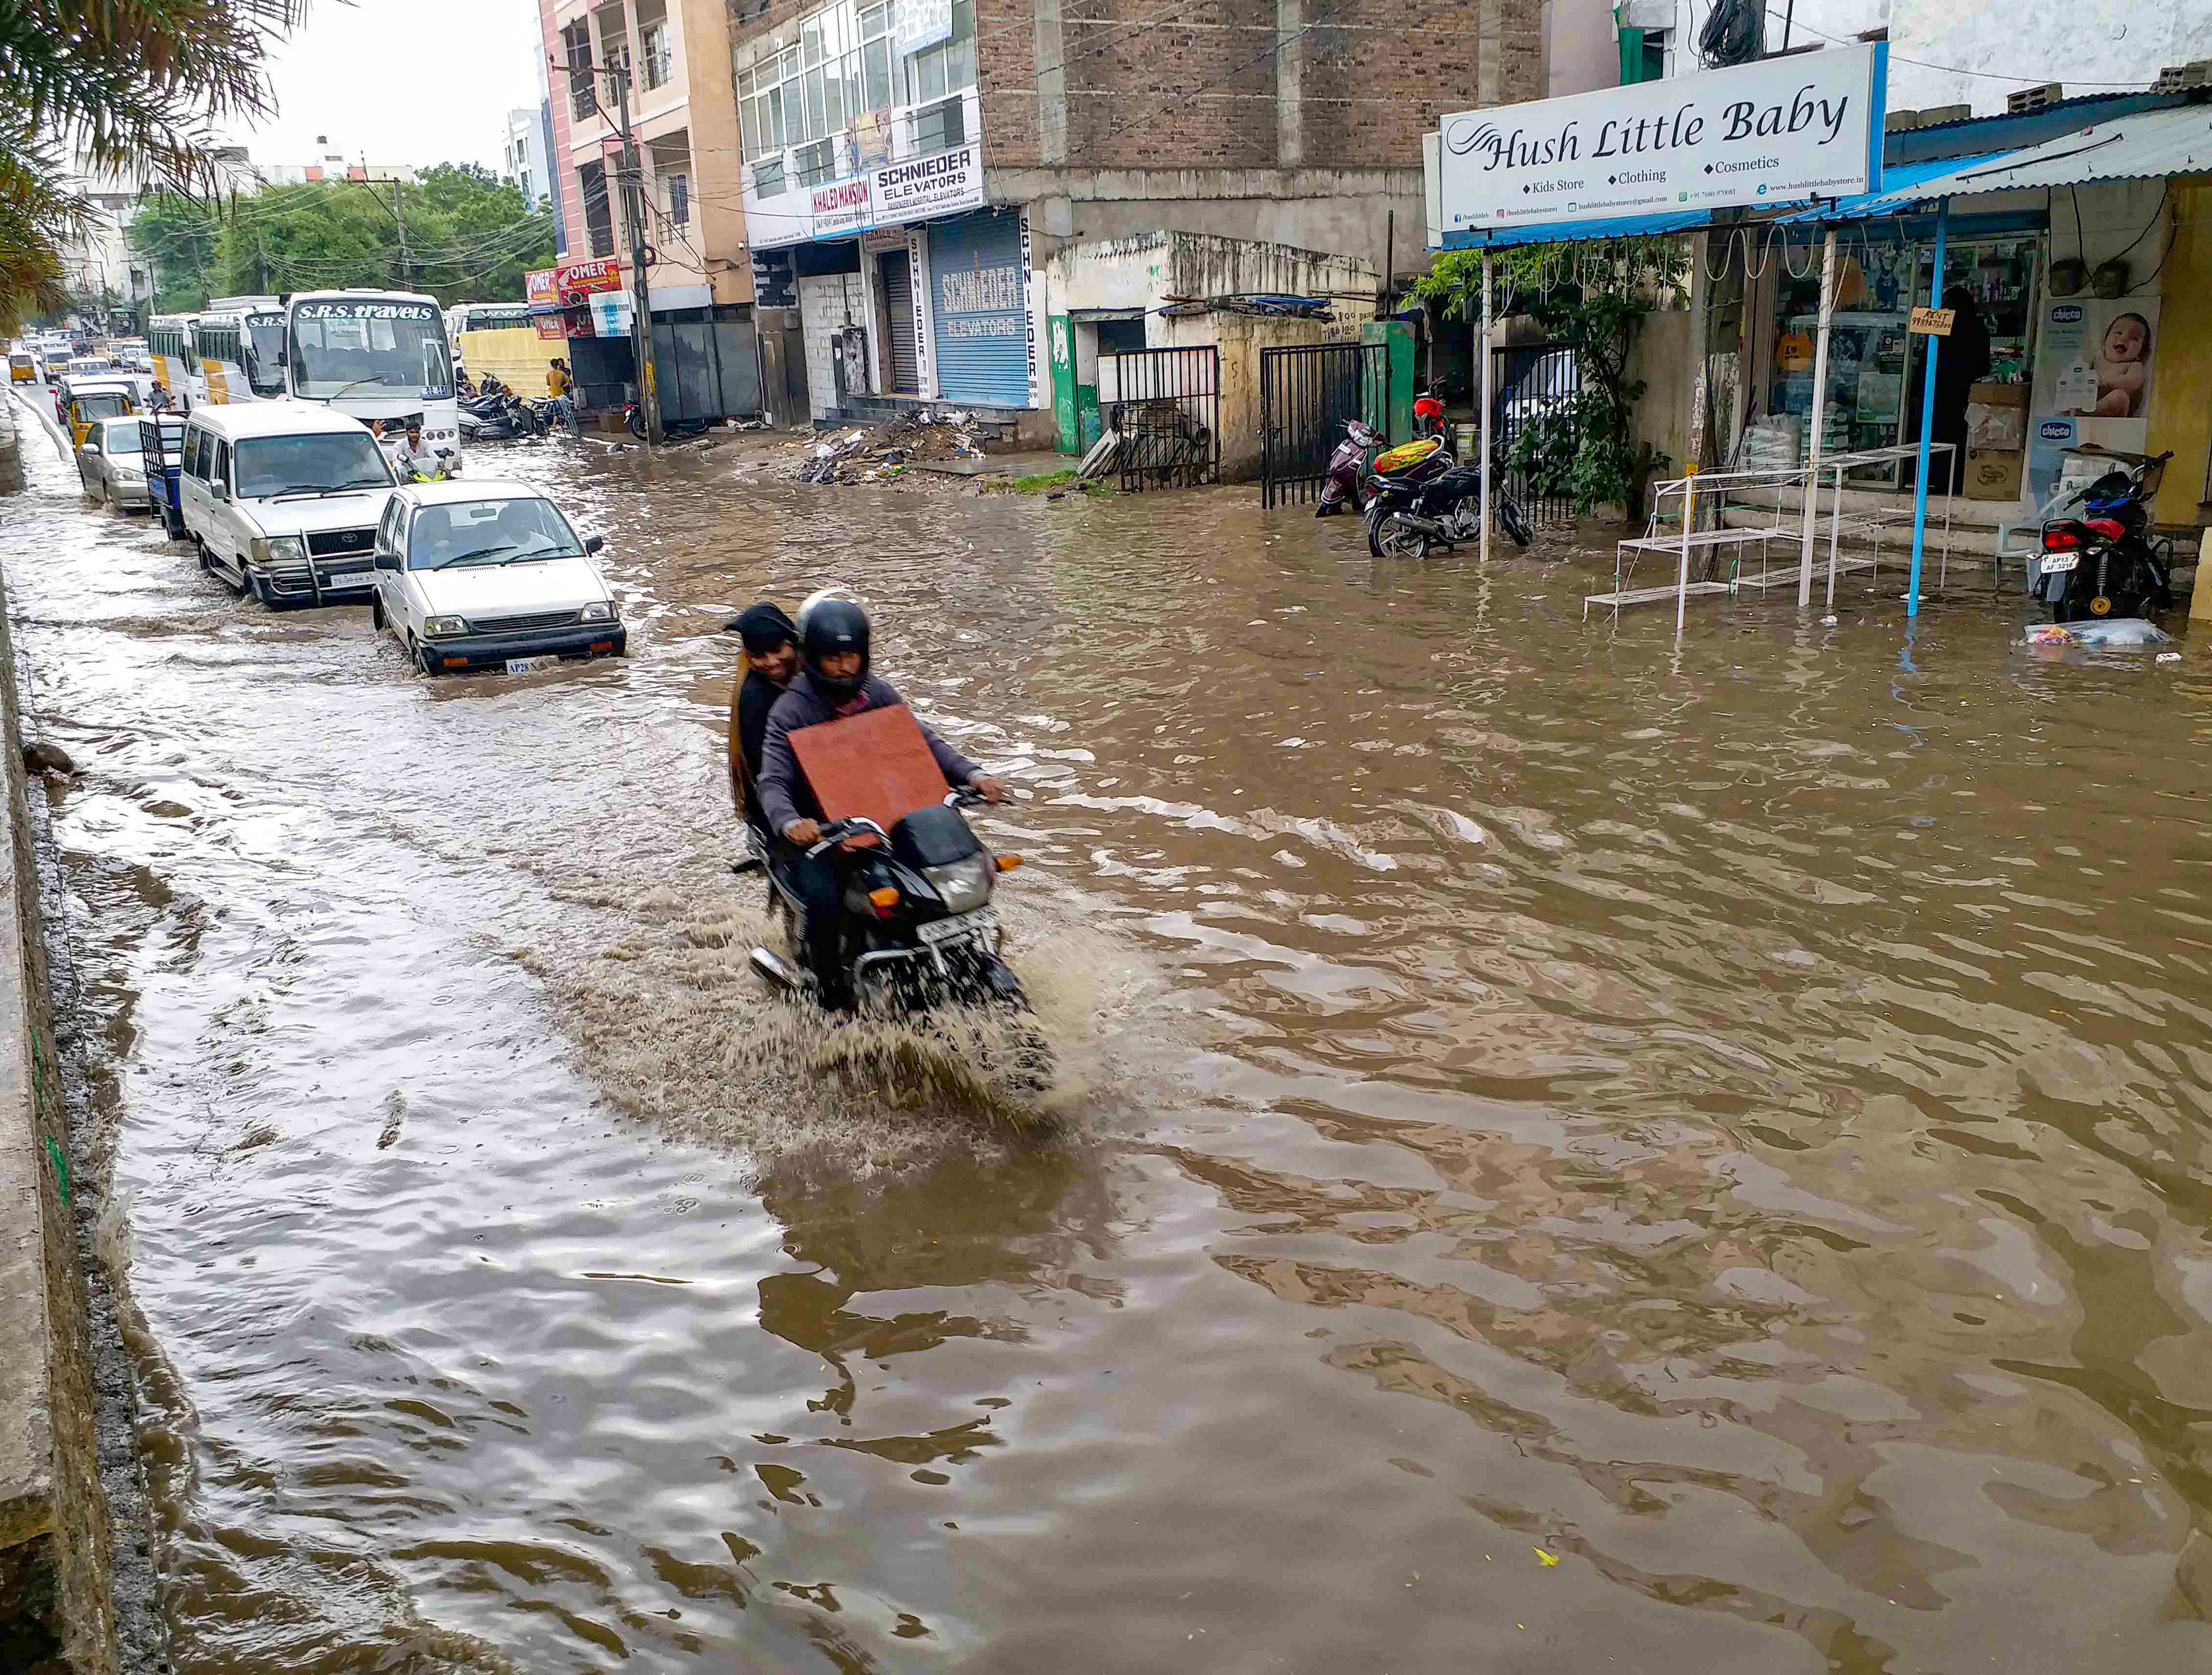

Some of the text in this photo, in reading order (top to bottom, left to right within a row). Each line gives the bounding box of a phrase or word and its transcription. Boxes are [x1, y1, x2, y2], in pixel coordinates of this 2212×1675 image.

[1483, 84, 1848, 171] Hush Little Baby
[878, 149, 971, 188] SCHNIEDER
[1715, 156, 1779, 174] Cosmetics
[884, 171, 966, 200] ELEVATORS
[1618, 169, 1666, 184] Clothing
[1770, 176, 1864, 192] www.hushlittlebabystore.in
[1533, 179, 1584, 194] Kids Store
[813, 180, 868, 214] KHALED MANSION
[570, 262, 607, 280] OMER
[532, 272, 551, 292] OMER
[911, 238, 925, 358] SCHNIEDER
[1021, 217, 1036, 377] SCHNIEDER
[1923, 310, 1950, 321] RENT
[2053, 307, 2081, 320] chicco
[2042, 424, 2070, 438] chicco
